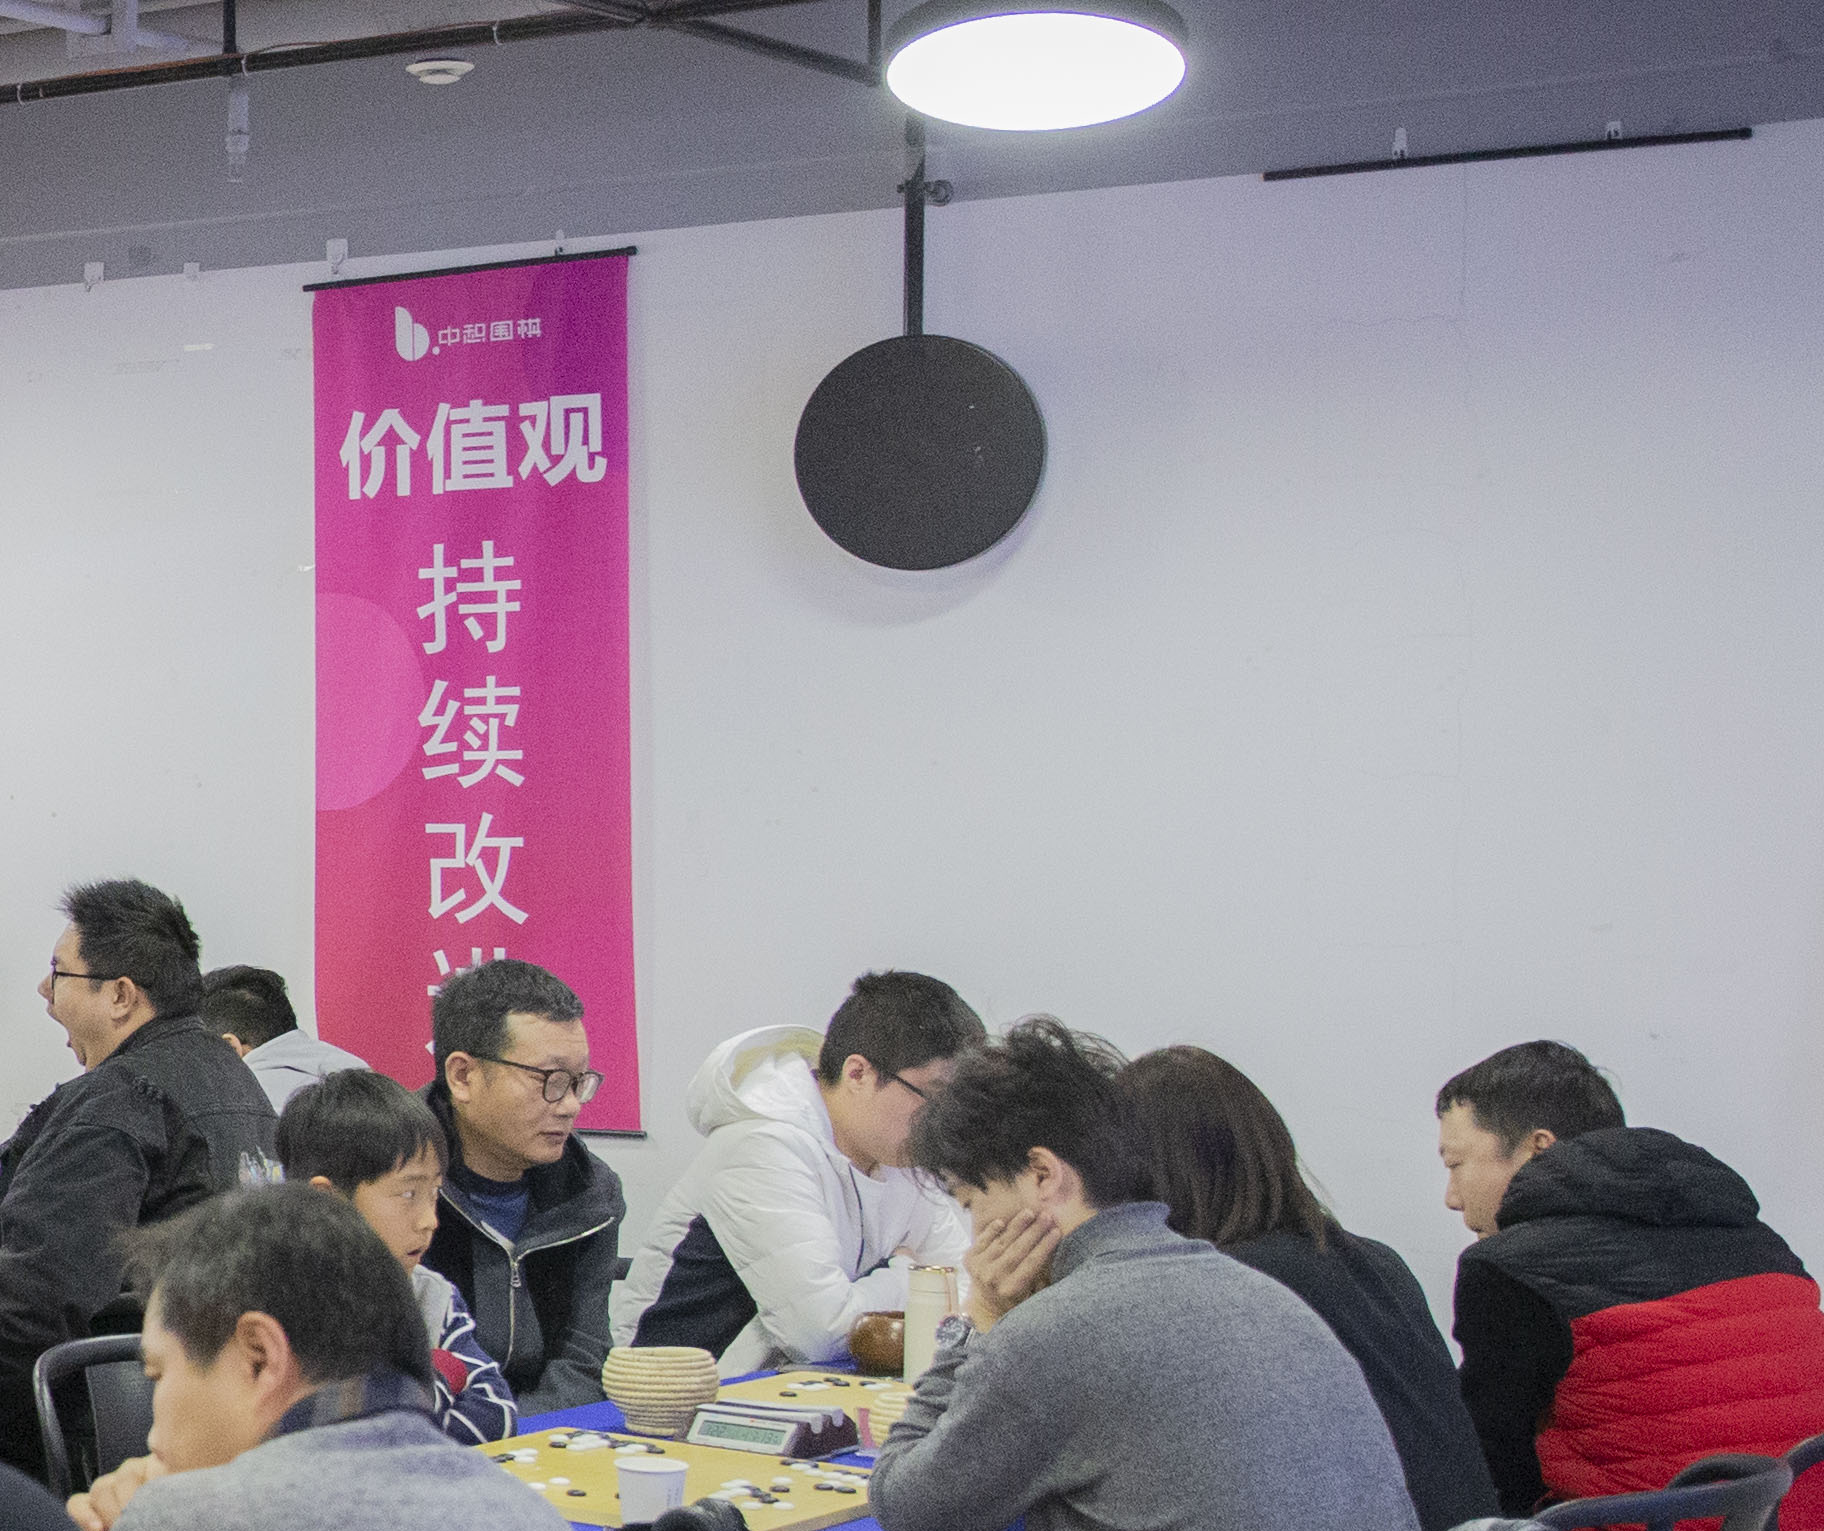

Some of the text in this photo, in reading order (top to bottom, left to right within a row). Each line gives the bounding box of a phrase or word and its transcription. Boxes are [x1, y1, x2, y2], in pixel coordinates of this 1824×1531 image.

[339, 393, 608, 500] 价值观
[416, 540, 529, 1056] 持续改
